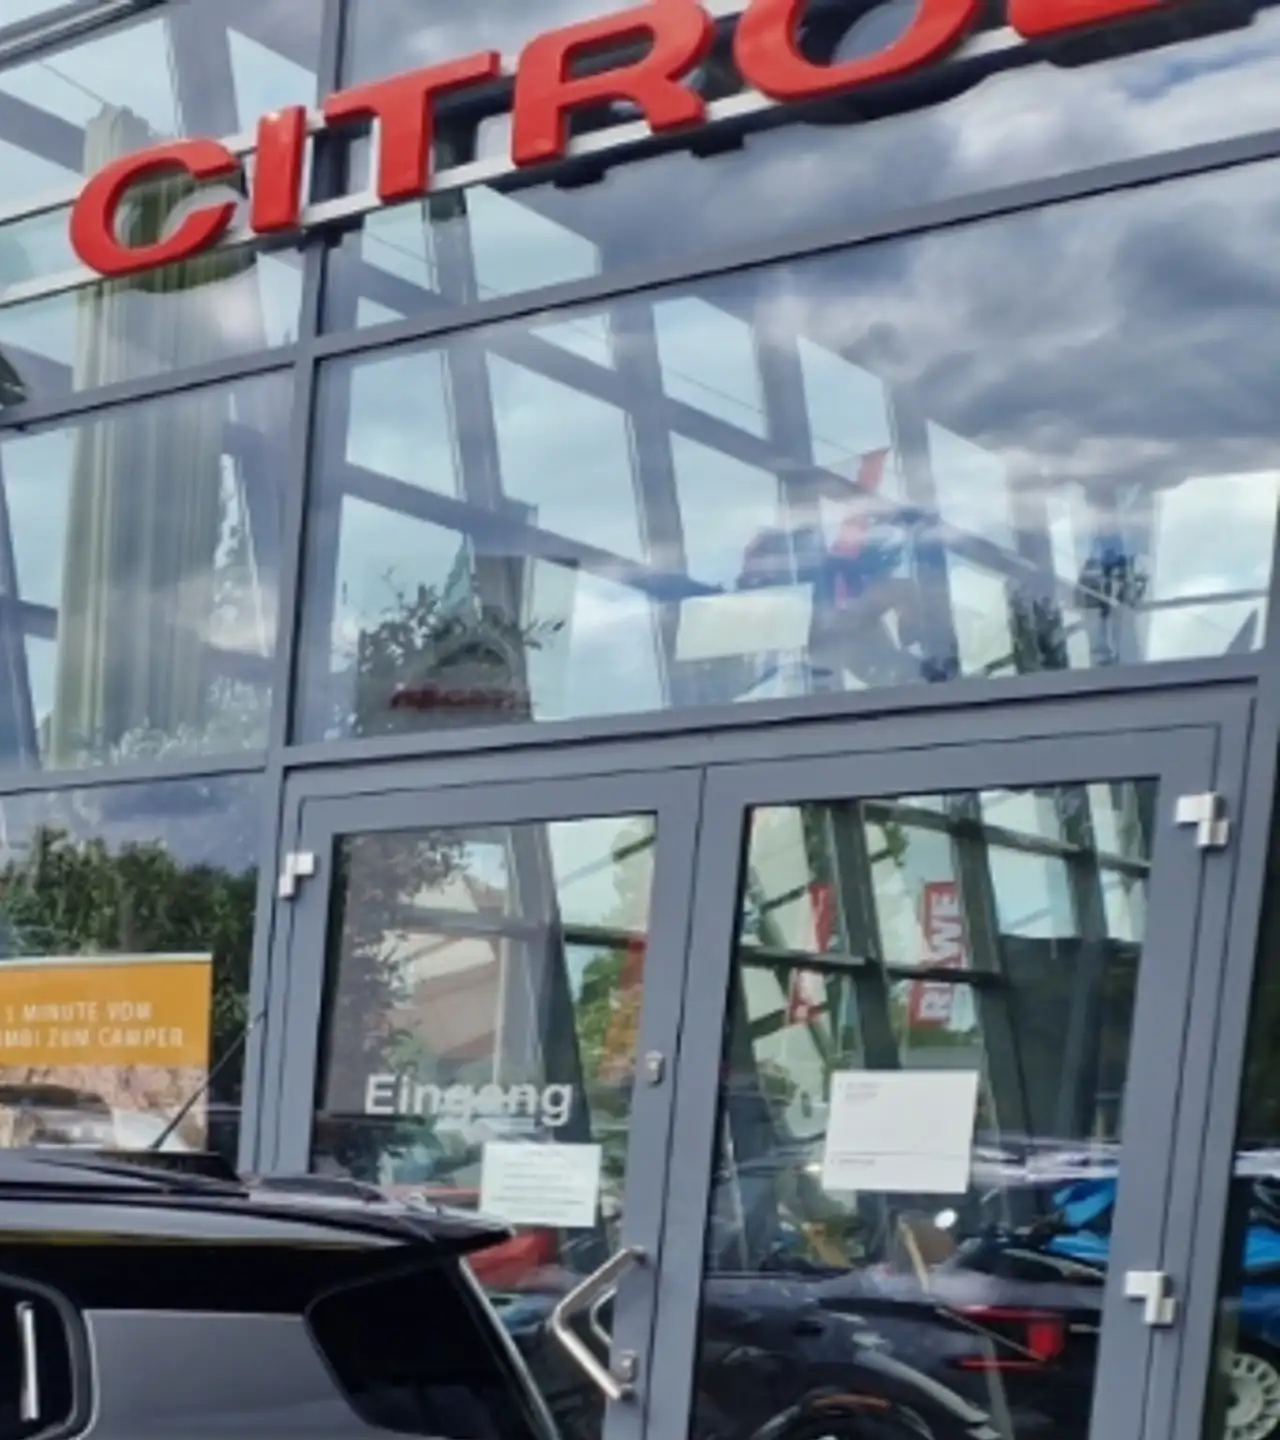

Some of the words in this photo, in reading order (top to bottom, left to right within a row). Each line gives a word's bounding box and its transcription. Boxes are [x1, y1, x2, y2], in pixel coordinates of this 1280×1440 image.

[69, 0, 1164, 276] CITRO
[22, 1001, 99, 1022] MINUTE
[106, 1000, 154, 1021] VOM
[46, 1028, 90, 1048] ZUM
[97, 1026, 185, 1048] CAMPER
[364, 1073, 574, 1127] Eingang
